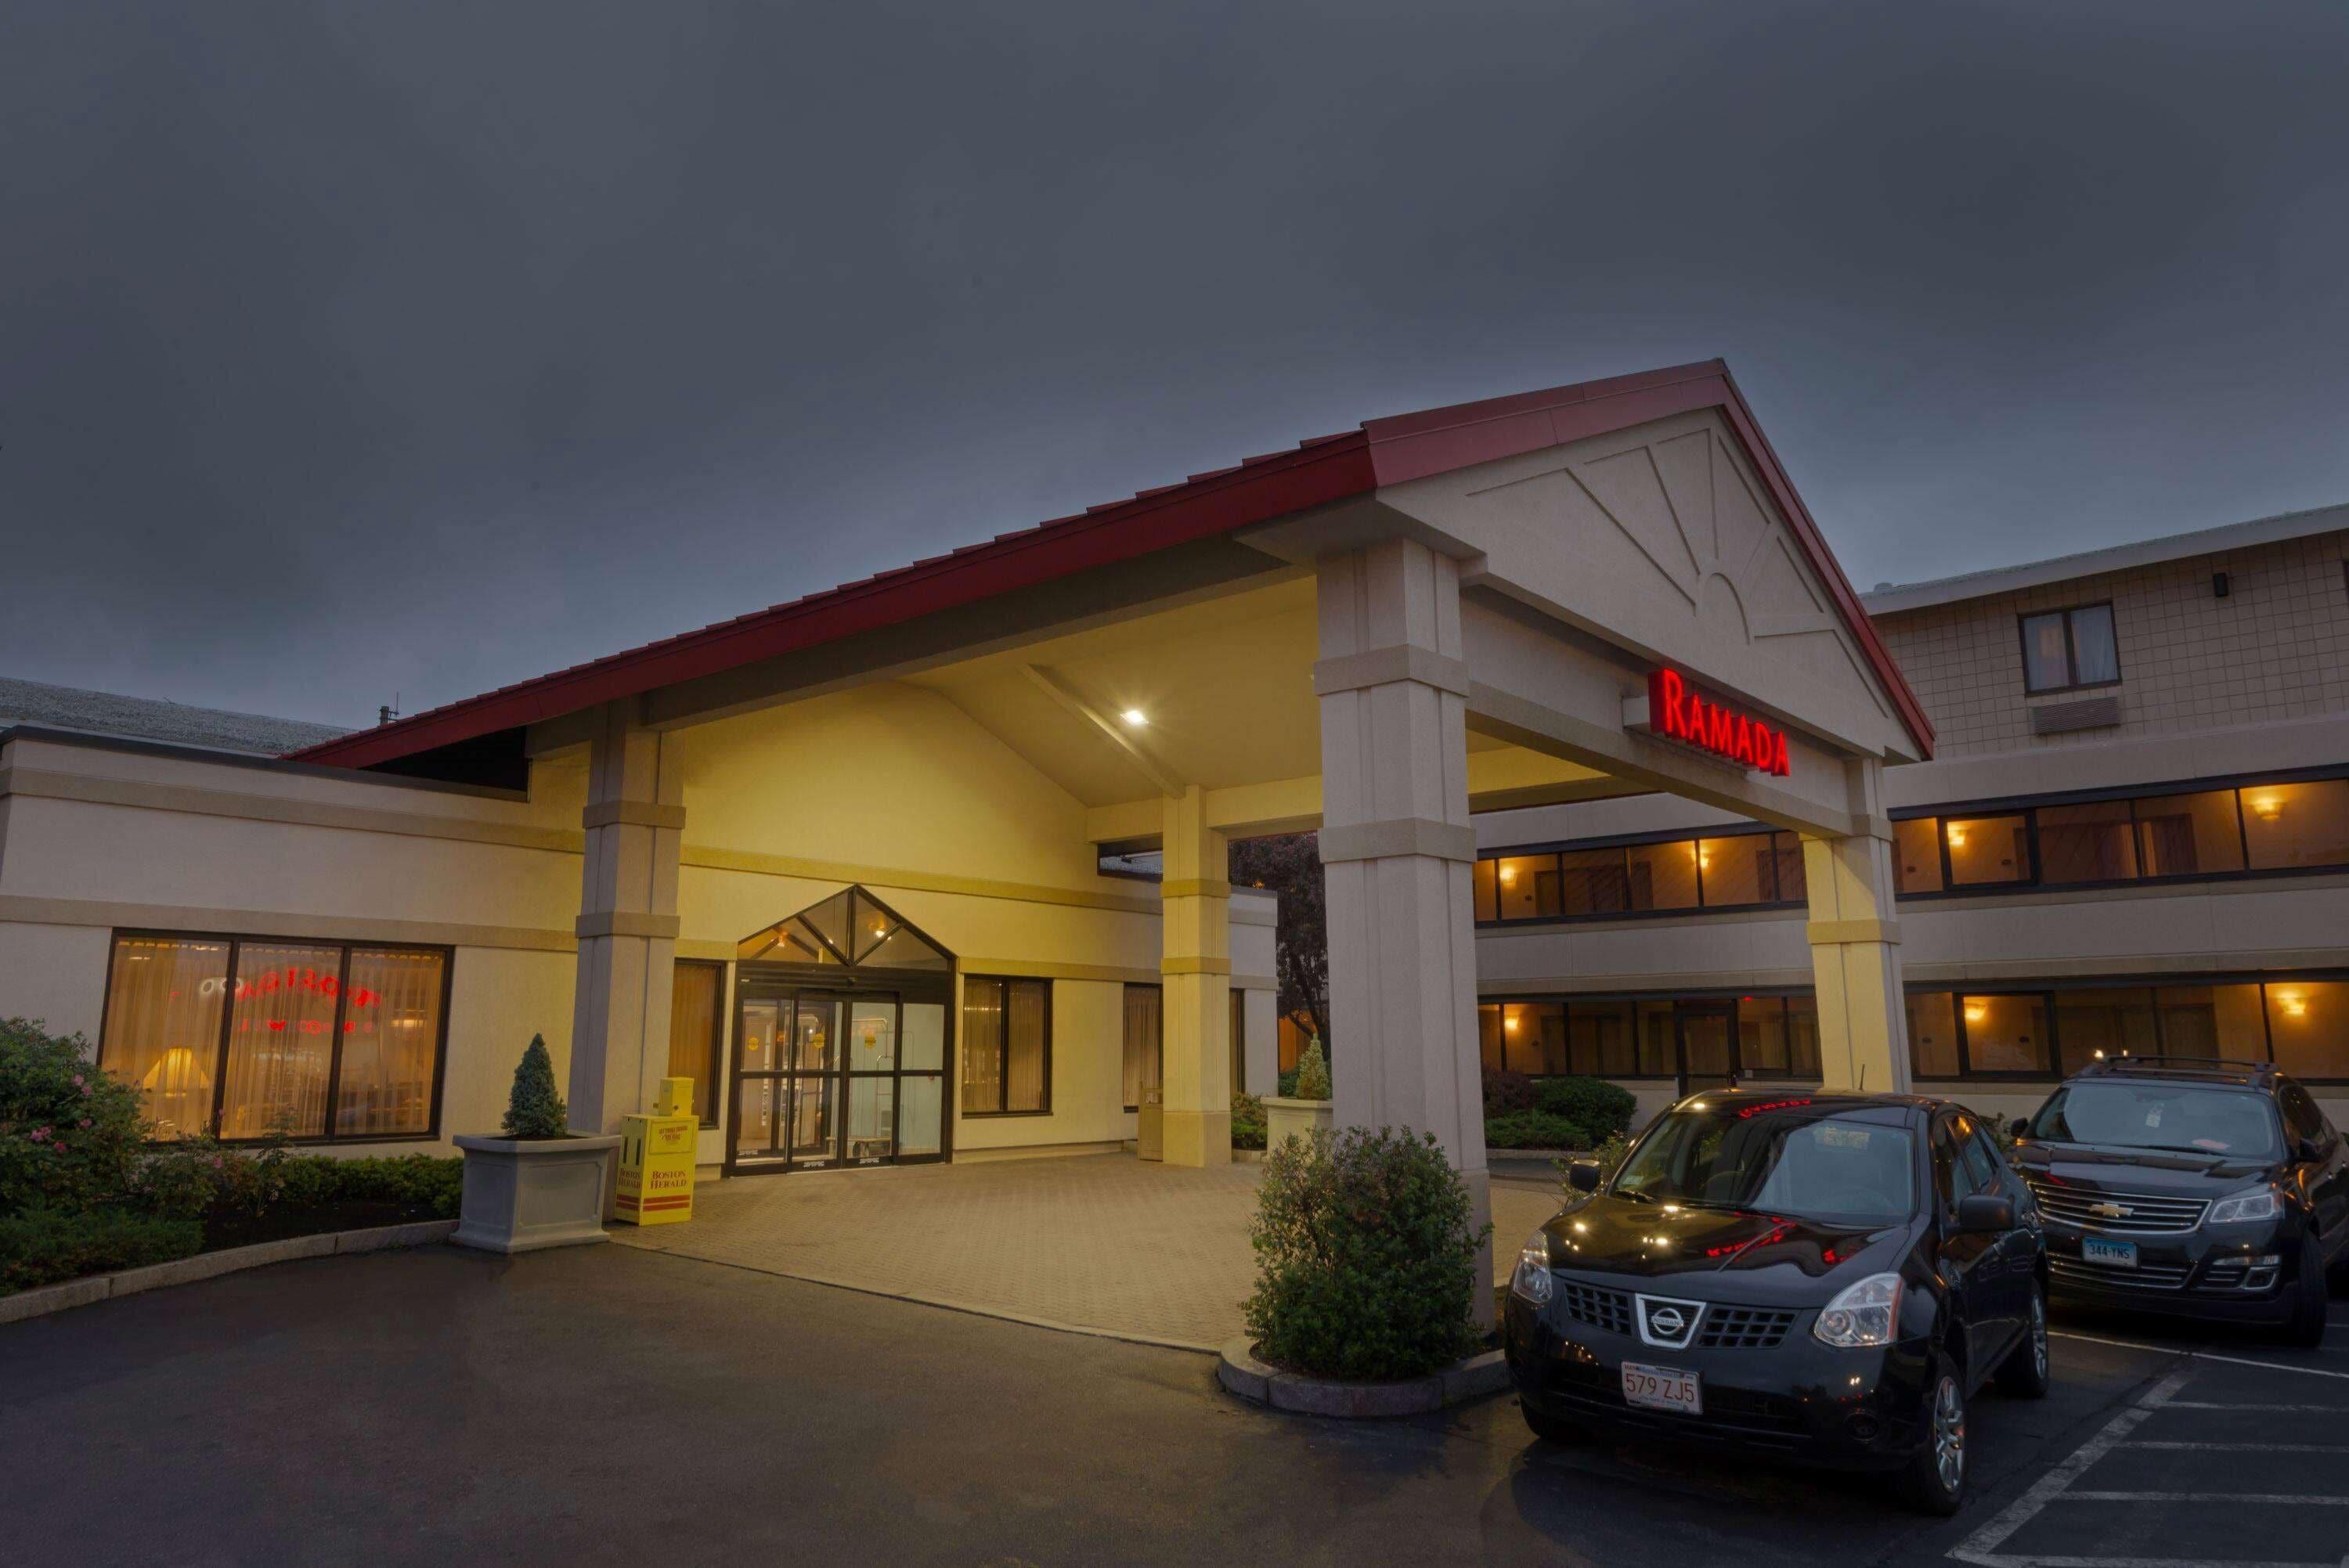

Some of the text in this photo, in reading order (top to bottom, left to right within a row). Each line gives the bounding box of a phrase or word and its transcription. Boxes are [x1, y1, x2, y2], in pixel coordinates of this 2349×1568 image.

[1662, 668, 1791, 777] RAMADA
[620, 1167, 640, 1178] BOSTON
[652, 1170, 686, 1180] BOSTON
[651, 1179, 687, 1190] HERALD
[1653, 1317, 1680, 1326] NISSAN
[1626, 1373, 1657, 1395] 579
[1662, 1379, 1694, 1403] ZJ5
